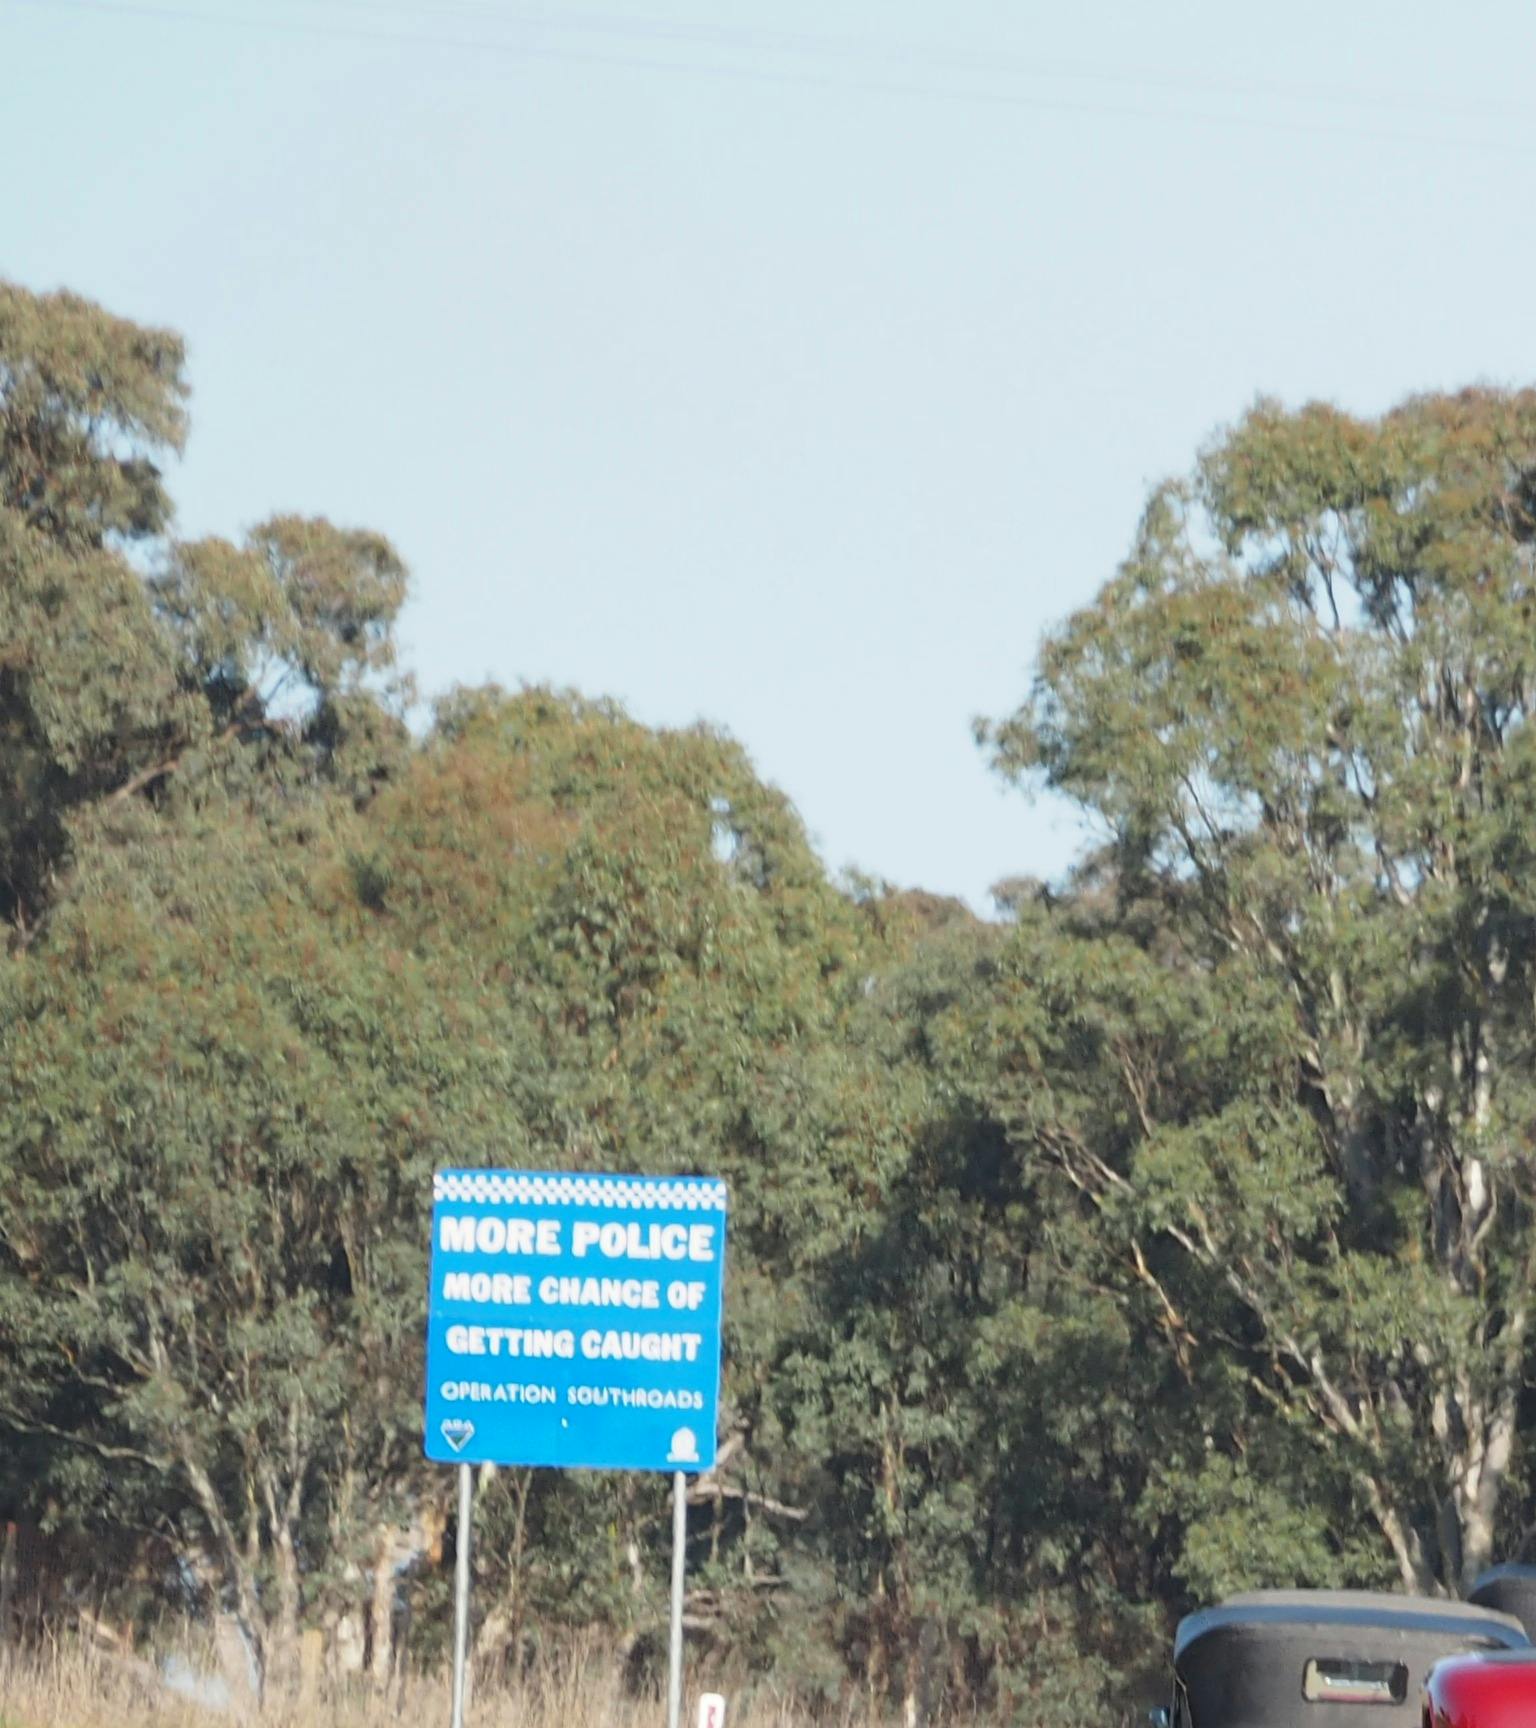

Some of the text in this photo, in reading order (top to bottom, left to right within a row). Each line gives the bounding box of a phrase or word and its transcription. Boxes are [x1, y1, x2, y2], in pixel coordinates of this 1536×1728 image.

[439, 1216, 715, 1262] MORE POLICE
[443, 1272, 706, 1311] MORE CHANCE OF
[445, 1325, 702, 1361] GETTING CAUGHT
[440, 1381, 705, 1410] OPERATION SOUTHROADS
